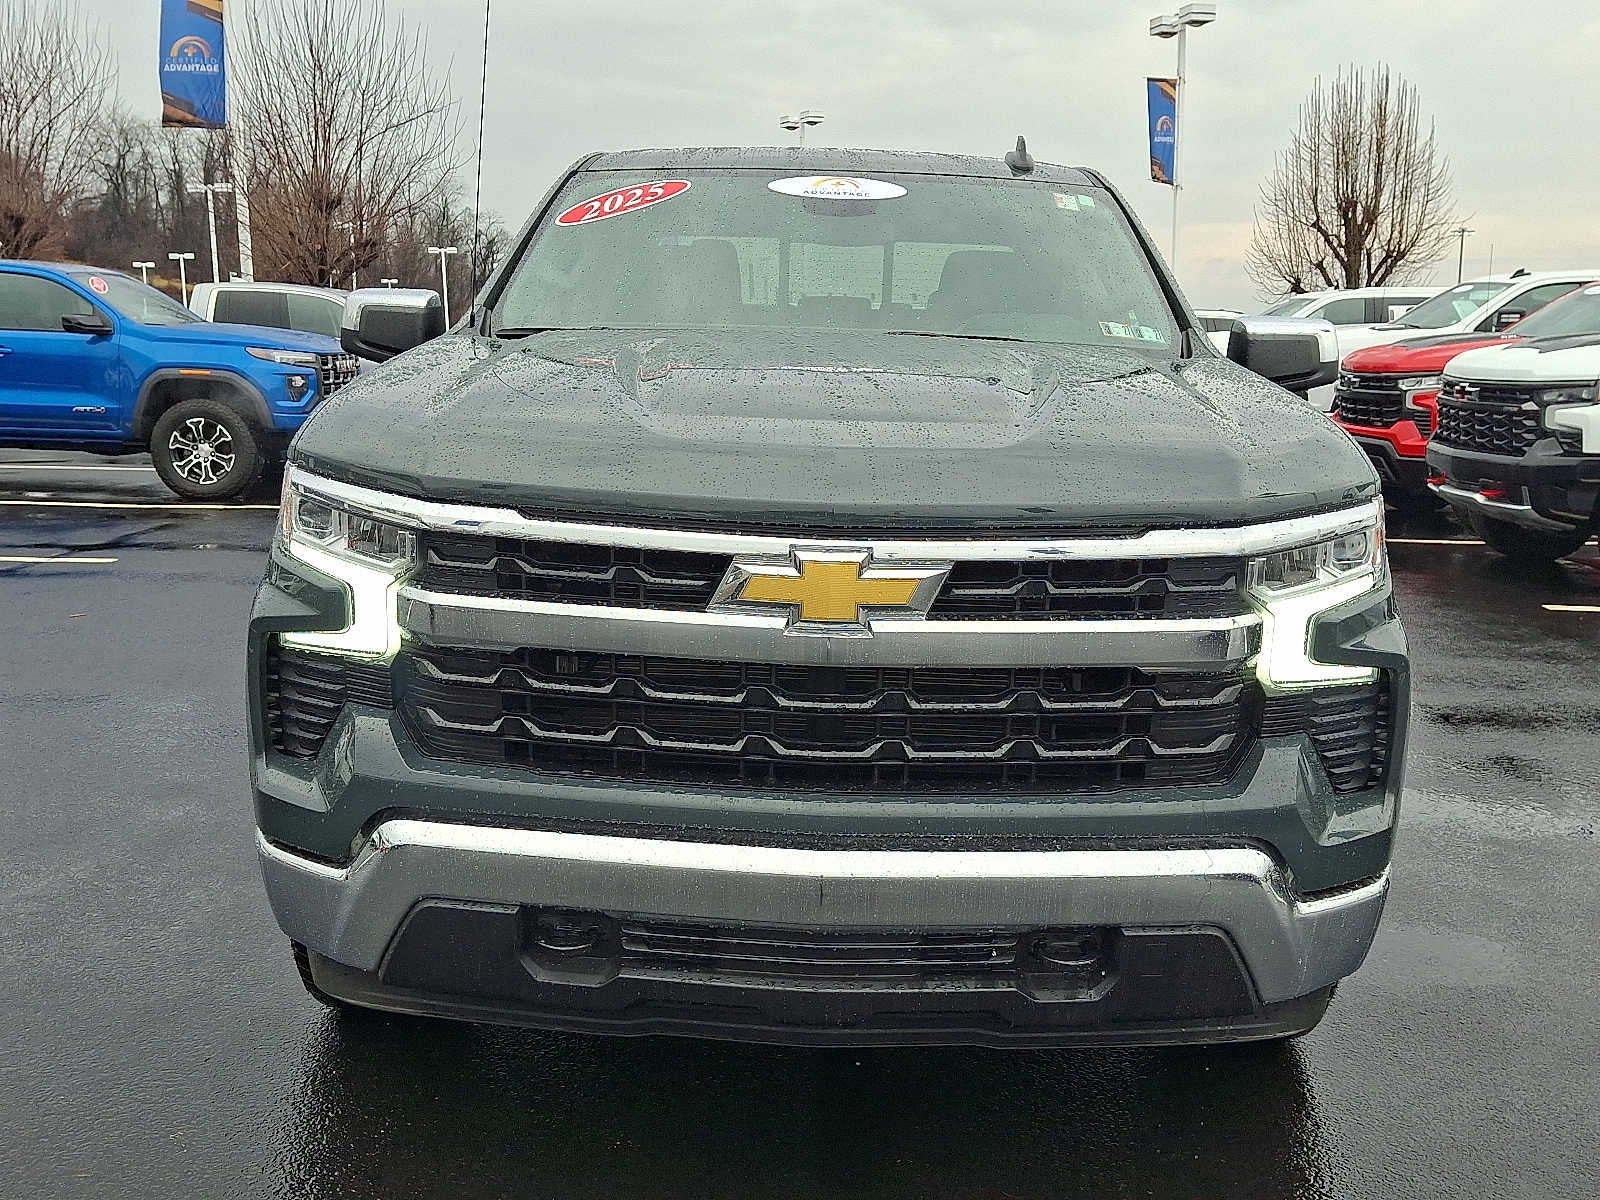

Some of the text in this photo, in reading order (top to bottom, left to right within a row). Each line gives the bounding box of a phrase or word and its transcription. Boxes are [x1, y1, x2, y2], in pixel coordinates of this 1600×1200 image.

[163, 63, 219, 73] ADVANTAGE
[803, 190, 870, 198] ADVANTAGE
[581, 183, 667, 220] 2025
